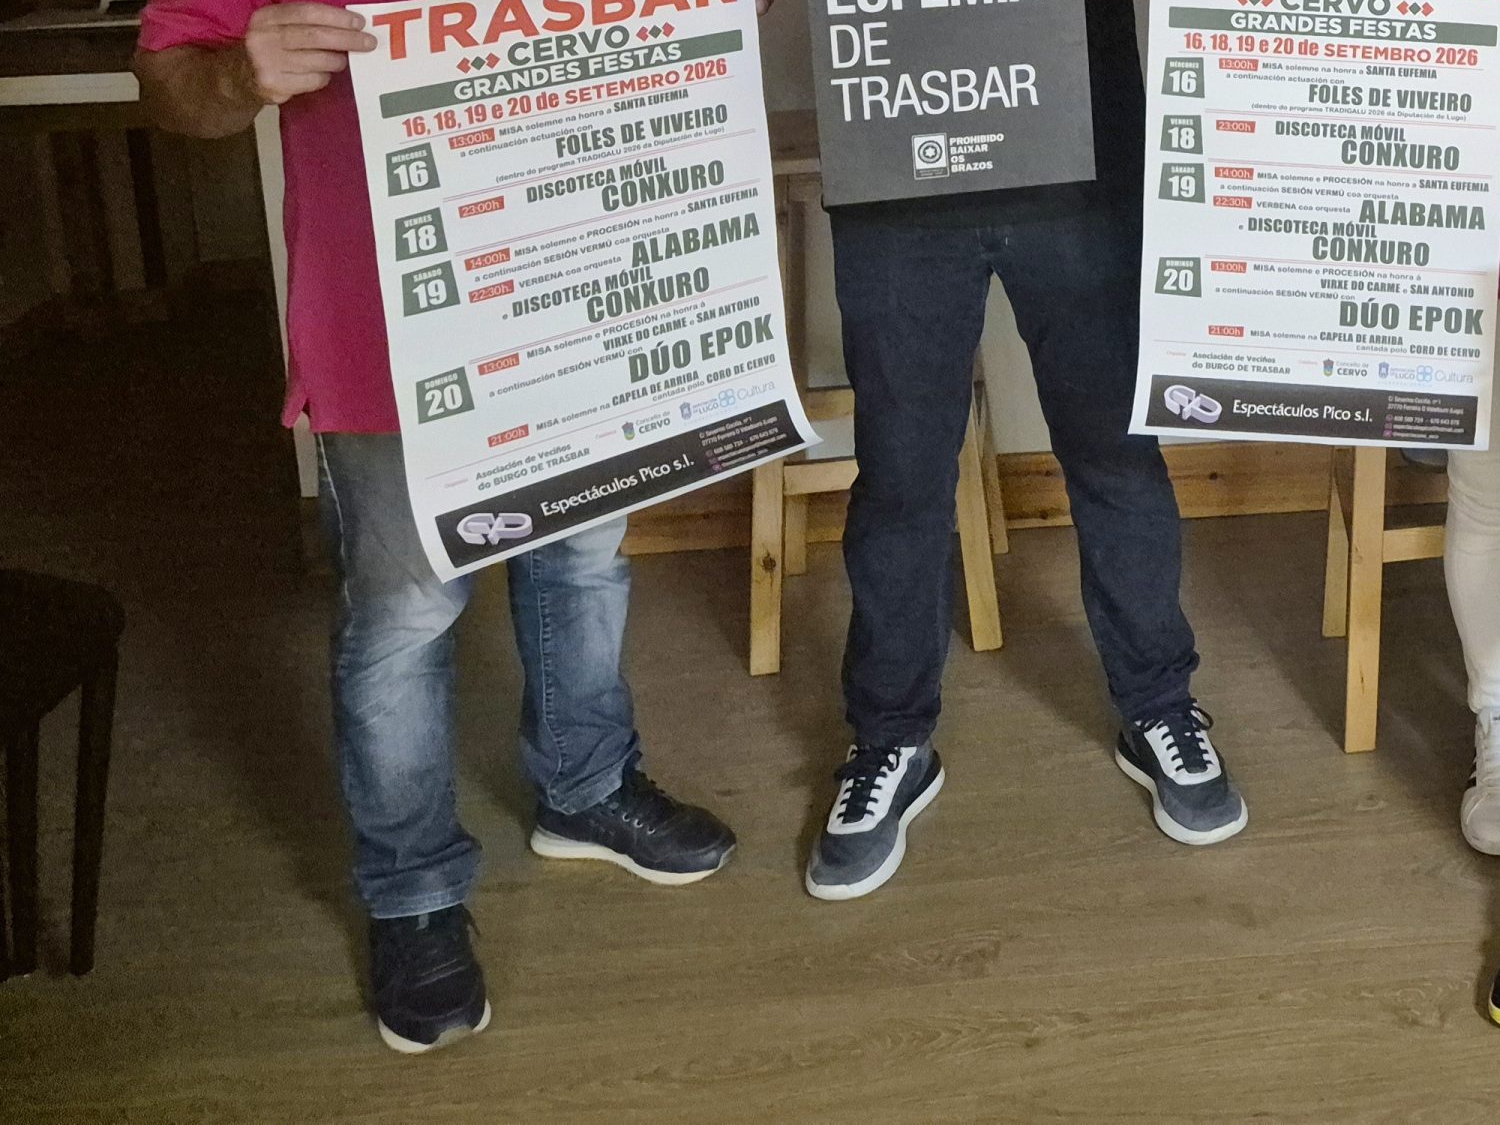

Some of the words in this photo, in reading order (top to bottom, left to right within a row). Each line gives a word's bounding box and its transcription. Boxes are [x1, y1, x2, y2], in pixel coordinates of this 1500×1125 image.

[1230, 13, 1342, 36] GRANDES
[1348, 19, 1437, 40] FESTAS
[507, 24, 630, 65] CERVO
[830, 22, 890, 69] DE
[1184, 33, 1207, 52] 16,
[1210, 34, 1233, 54] 18,
[1237, 35, 1255, 52] 19
[1259, 39, 1270, 53] e
[1274, 38, 1295, 55] 20
[1298, 39, 1319, 56] de
[1324, 43, 1431, 64] SETEMBRO
[1435, 46, 1478, 66] 2026
[454, 62, 581, 100] GRANDES
[587, 42, 681, 75] FESTAS
[1168, 71, 1196, 93] 16
[1221, 59, 1256, 69] 13:00h.
[1285, 63, 1319, 72] solemne
[1334, 66, 1356, 74] honra
[1366, 65, 1396, 77] SANTA
[1398, 67, 1437, 79] EUFEMIA
[402, 117, 430, 137] 16,
[466, 103, 486, 124] 19
[492, 106, 503, 119] e
[508, 96, 531, 117] 20
[536, 91, 559, 111] de
[565, 70, 680, 105] SETEMBRO
[684, 58, 727, 83] 2026
[830, 63, 1039, 122] TRASBAR
[1309, 84, 1363, 106] FOLES
[1369, 88, 1391, 107] DE
[1397, 90, 1472, 112] VIVEIRO
[556, 126, 616, 158] FOLES
[621, 119, 644, 144] DE
[649, 104, 728, 137] VIVEIRO
[950, 133, 1004, 146] PROHIBIDO
[951, 144, 988, 154] BAIXAR
[951, 155, 965, 163] OS
[1341, 140, 1460, 171] CONXURO
[951, 161, 993, 172] BRAZOS
[601, 160, 724, 213] CONXURO
[1215, 197, 1250, 207] 22:30h.
[1256, 201, 1296, 211] VERBENA
[1316, 205, 1351, 214] orquesta
[1358, 199, 1485, 230] ALABAMA
[631, 212, 760, 267] ALABAMA
[629, 340, 691, 384] DÚO
[700, 314, 774, 361] EPOK
[1409, 344, 1435, 355] CORO
[1437, 345, 1449, 356] DE
[1451, 346, 1480, 358] CERVO
[540, 474, 638, 517] Espectáculos
[638, 463, 671, 489] Pico
[673, 453, 694, 473] s.l.
